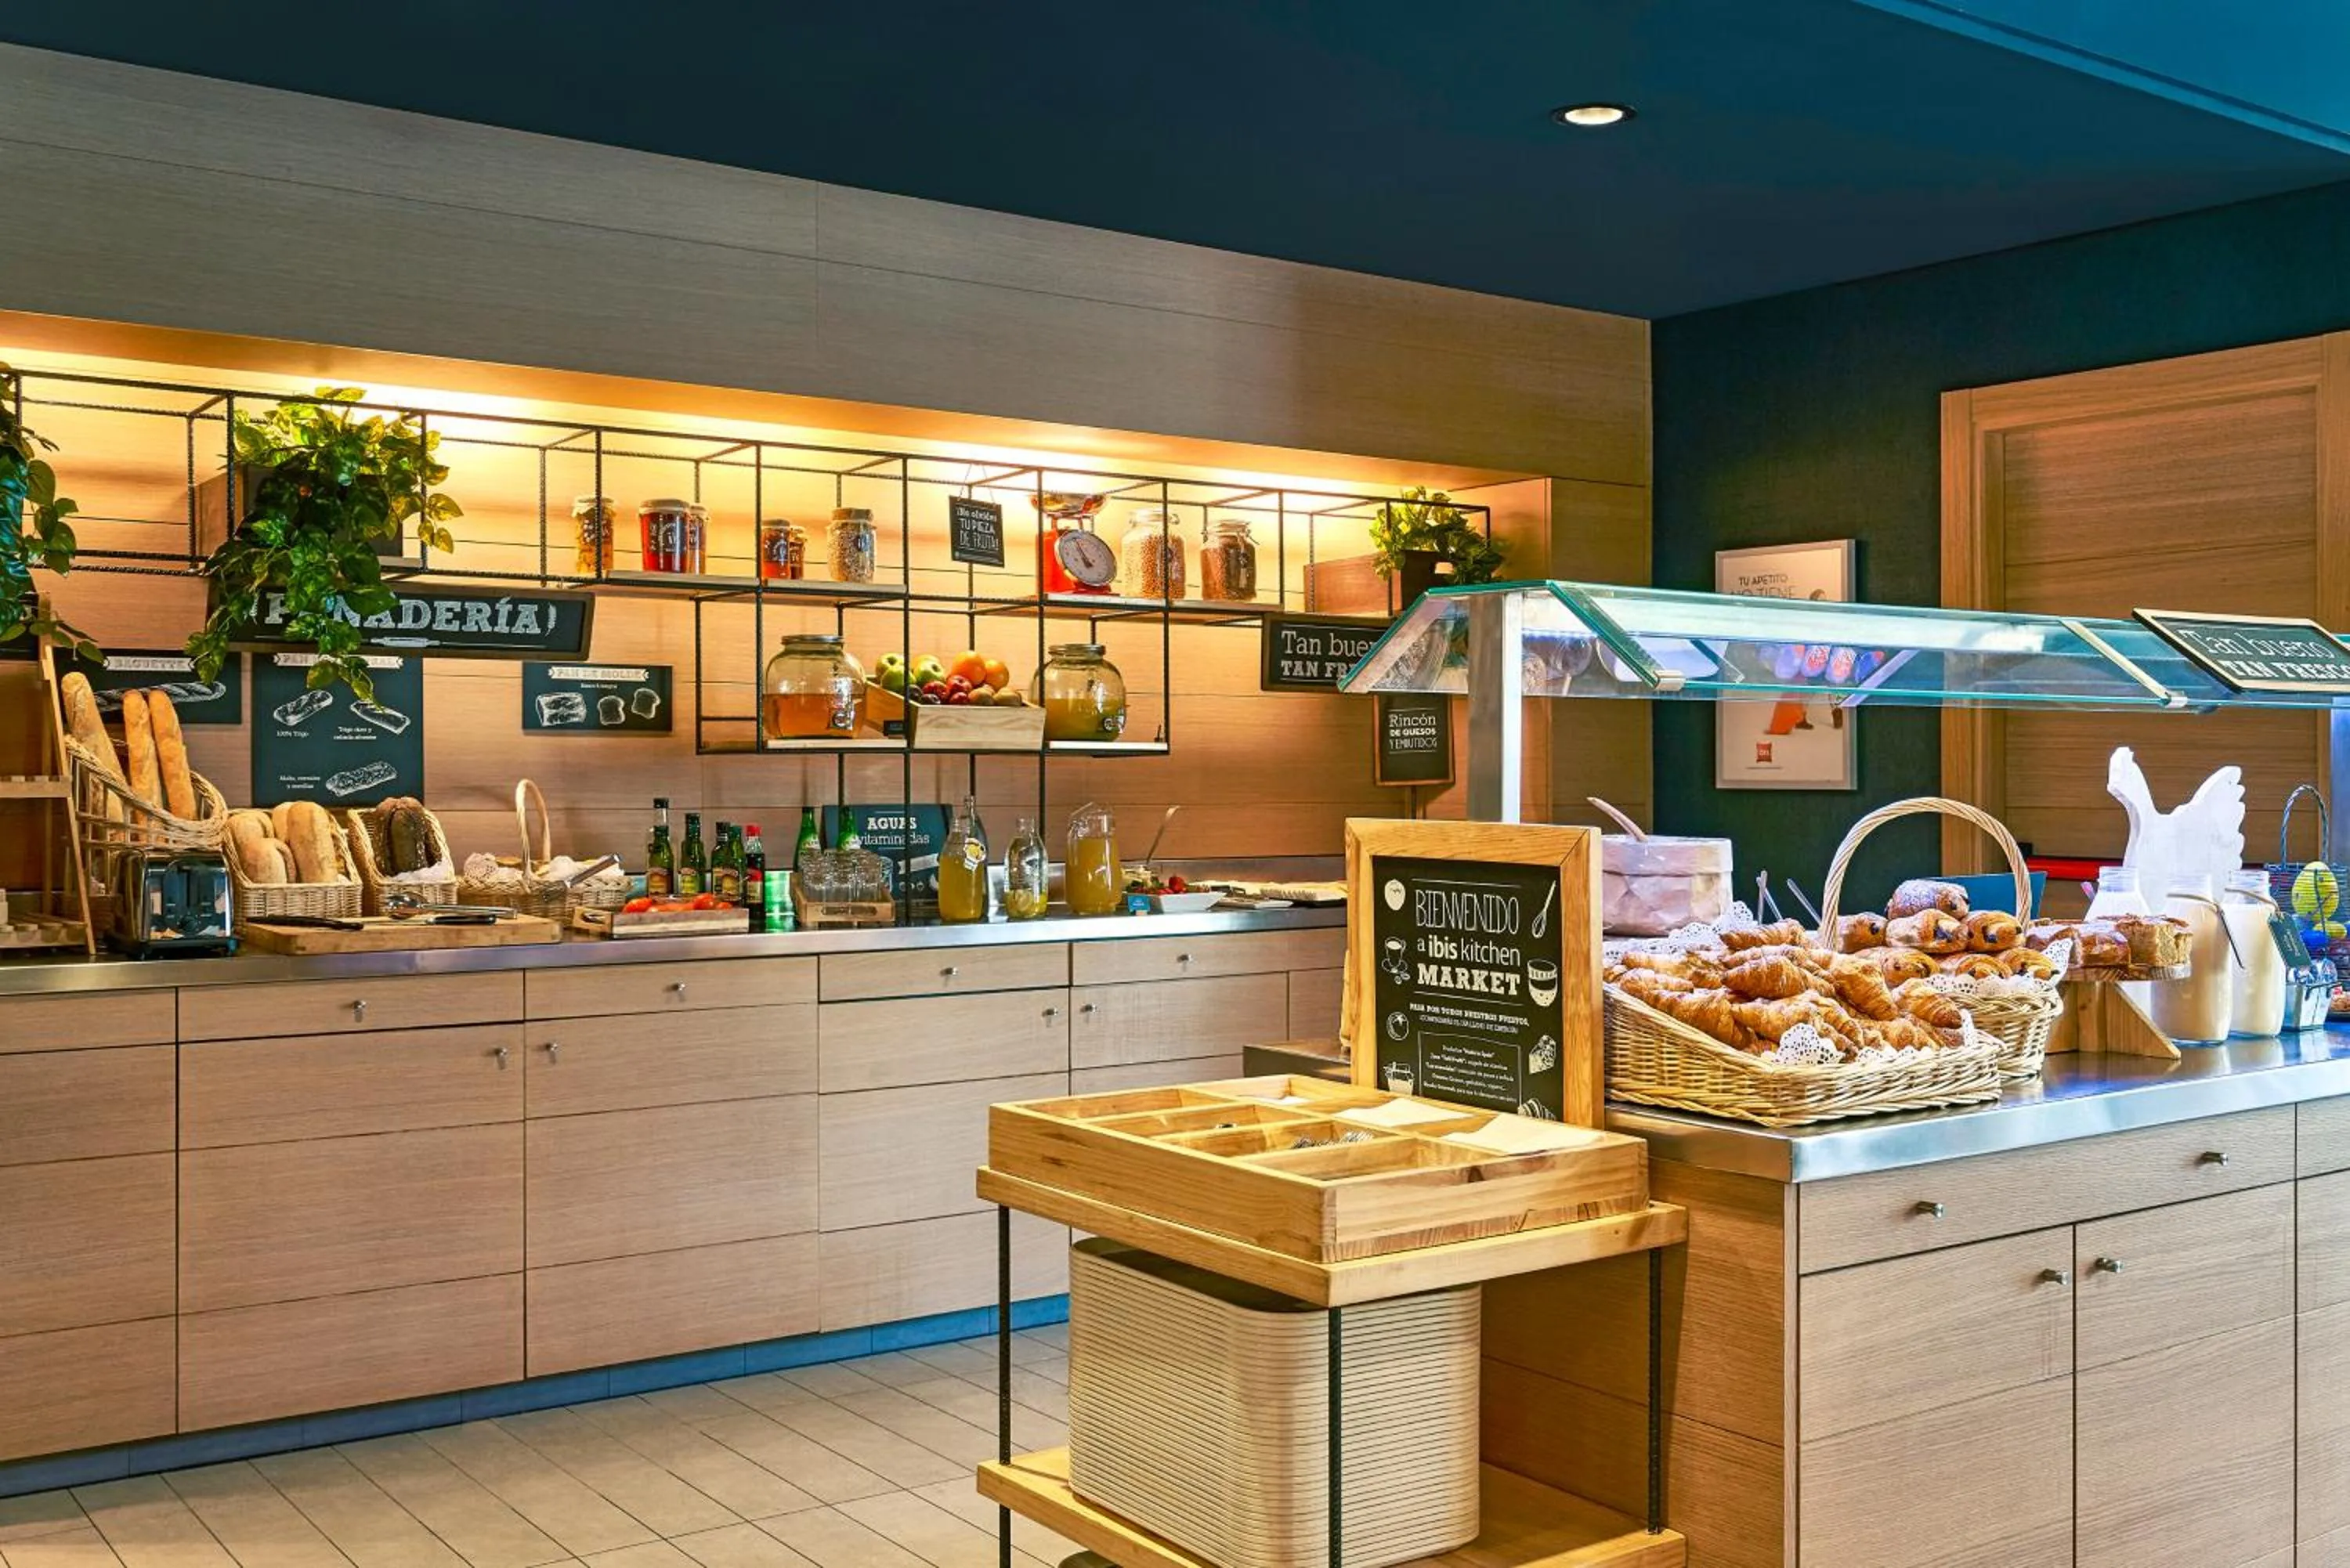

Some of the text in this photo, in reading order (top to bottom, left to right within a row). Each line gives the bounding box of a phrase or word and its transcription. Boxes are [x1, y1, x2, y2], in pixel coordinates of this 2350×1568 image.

[959, 518, 971, 530] TU
[960, 530, 971, 547] DE
[1739, 573, 1788, 586] TU APETITO
[1281, 630, 1373, 657] Tan bue
[2176, 629, 2335, 659] Tan bueno
[1280, 660, 1318, 677] TAN
[2217, 659, 2280, 677] TAN
[1388, 714, 1437, 728] Rincón
[1390, 728, 1437, 737] DE QUESOS
[1415, 889, 1520, 935] BIENVENIDO
[1416, 934, 1521, 968] a ibis kitchen
[1416, 963, 1521, 996] MARKET
